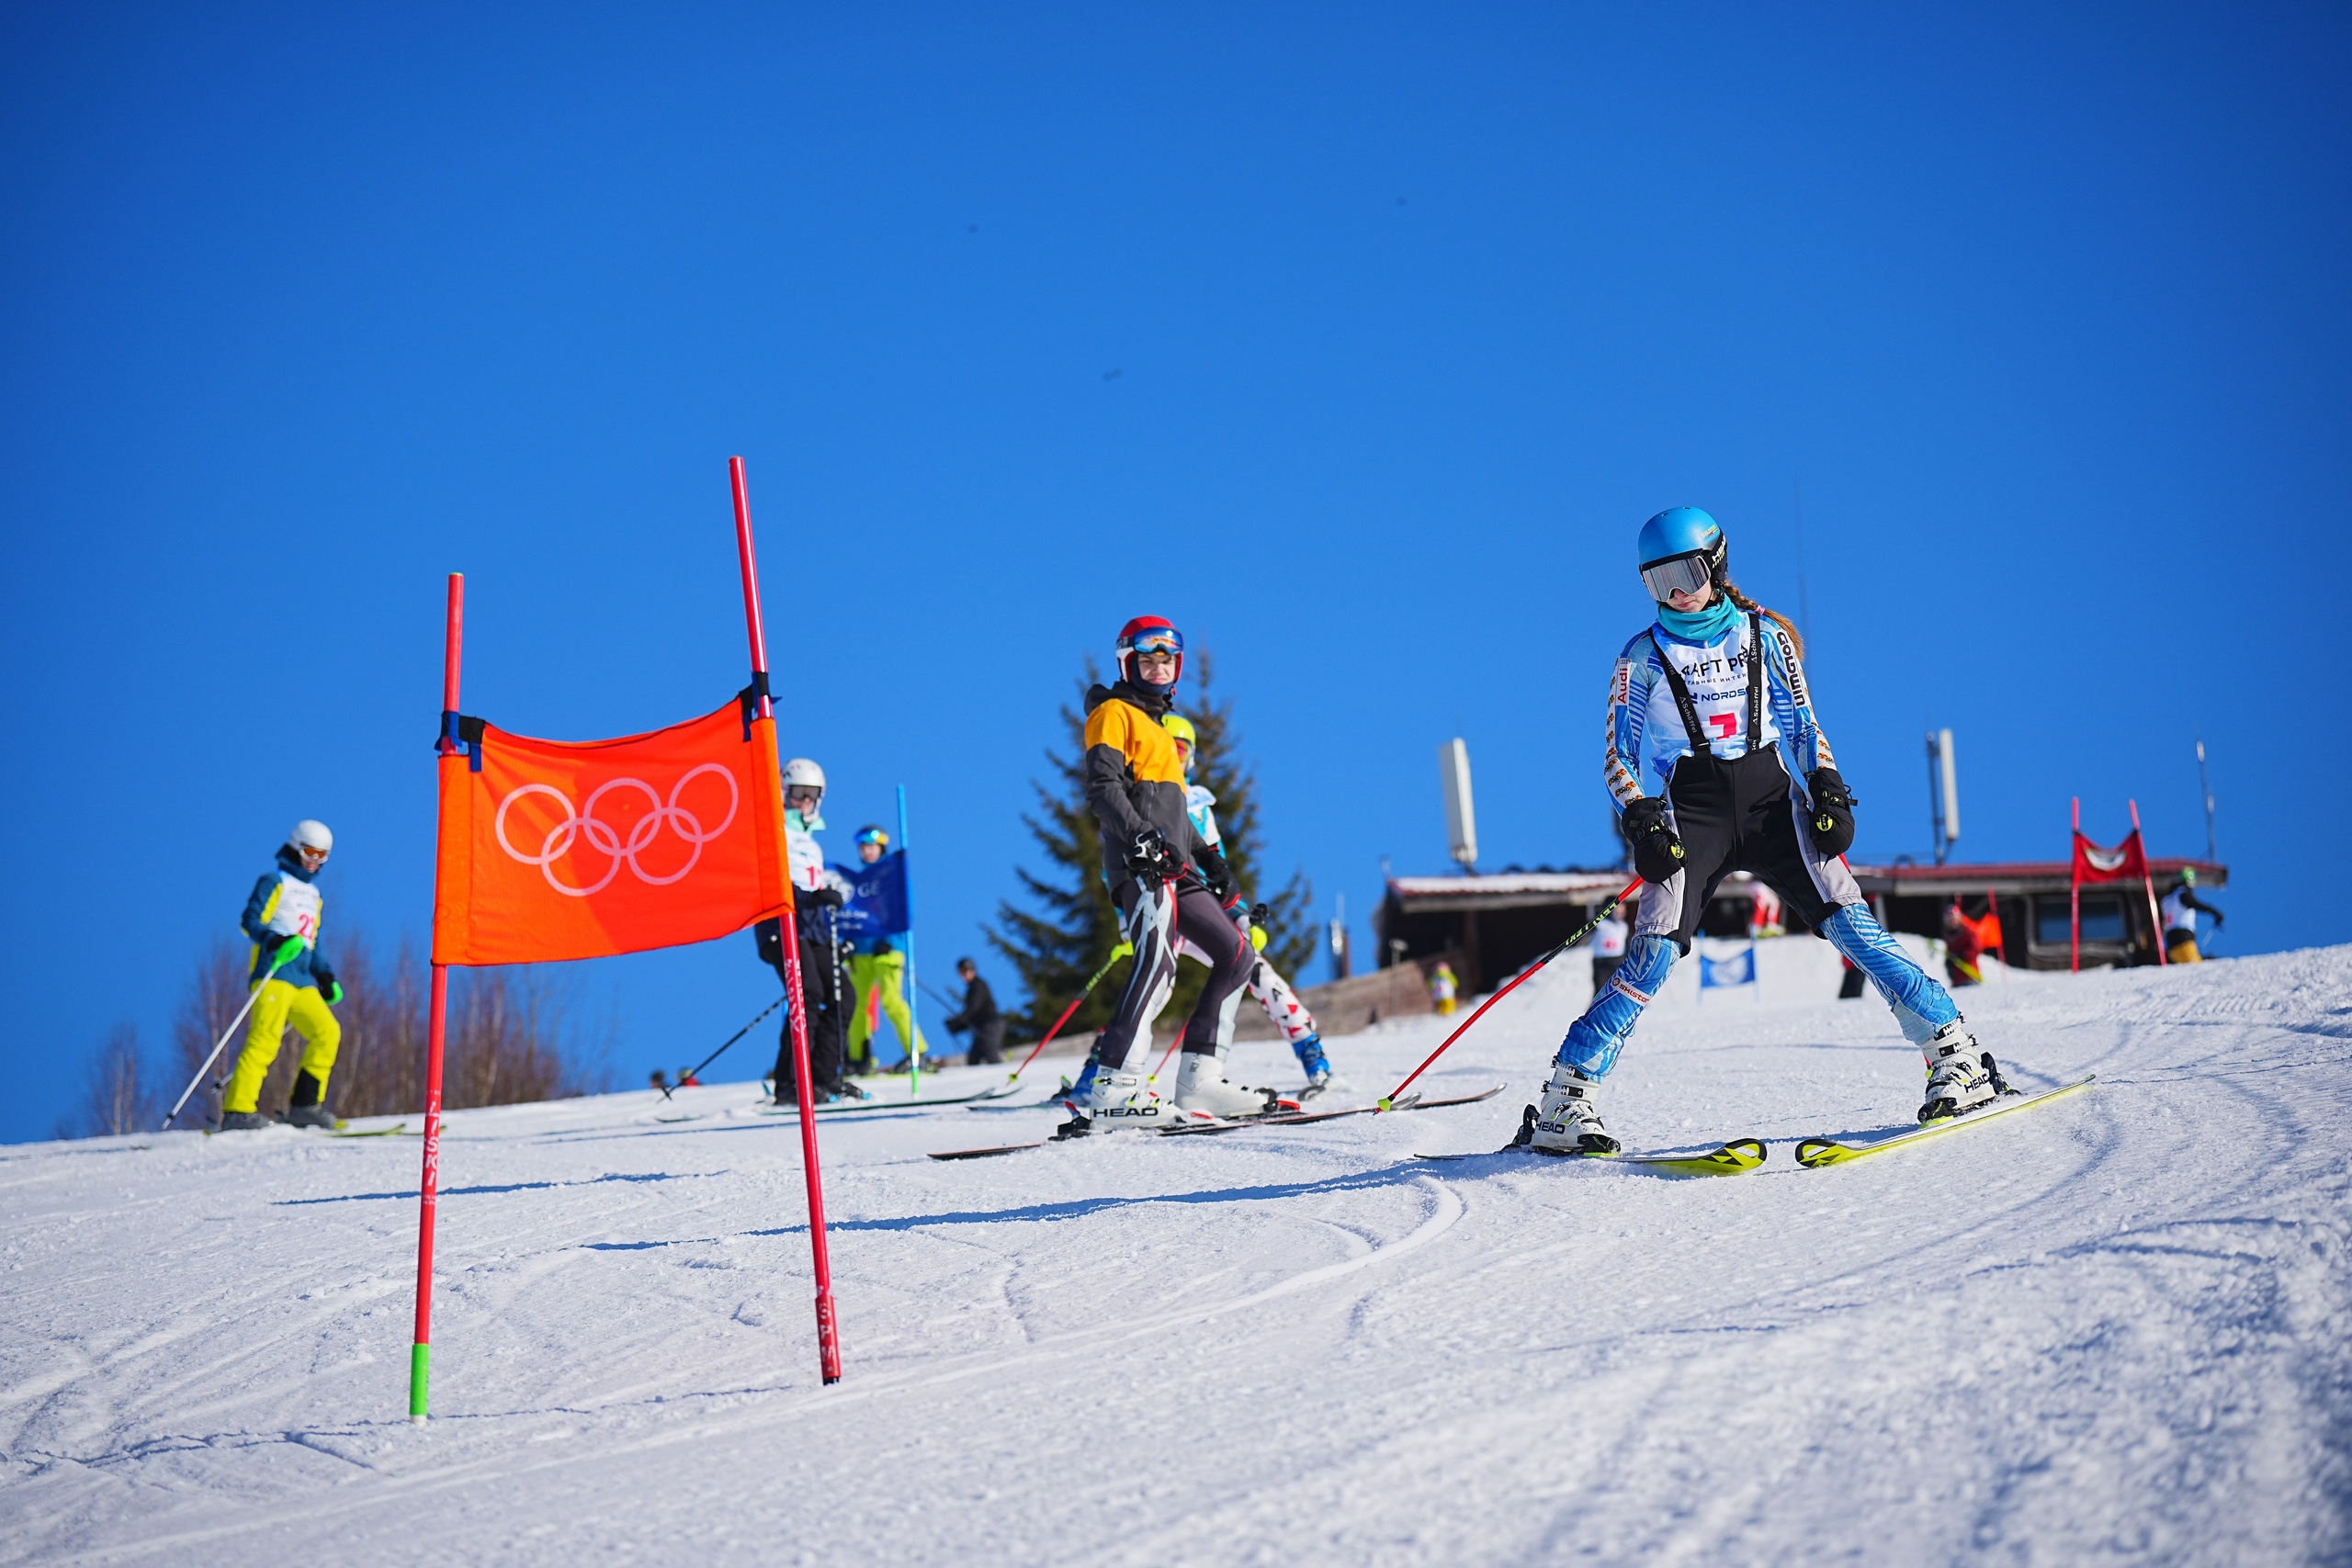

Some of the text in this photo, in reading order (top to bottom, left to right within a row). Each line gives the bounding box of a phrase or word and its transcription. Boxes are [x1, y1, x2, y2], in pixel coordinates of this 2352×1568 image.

[1617, 668, 1628, 704] Audi
[1963, 1073, 1992, 1093] HEAD
[1092, 1108, 1159, 1118] HEAD
[1535, 1120, 1566, 1134] HEAD
